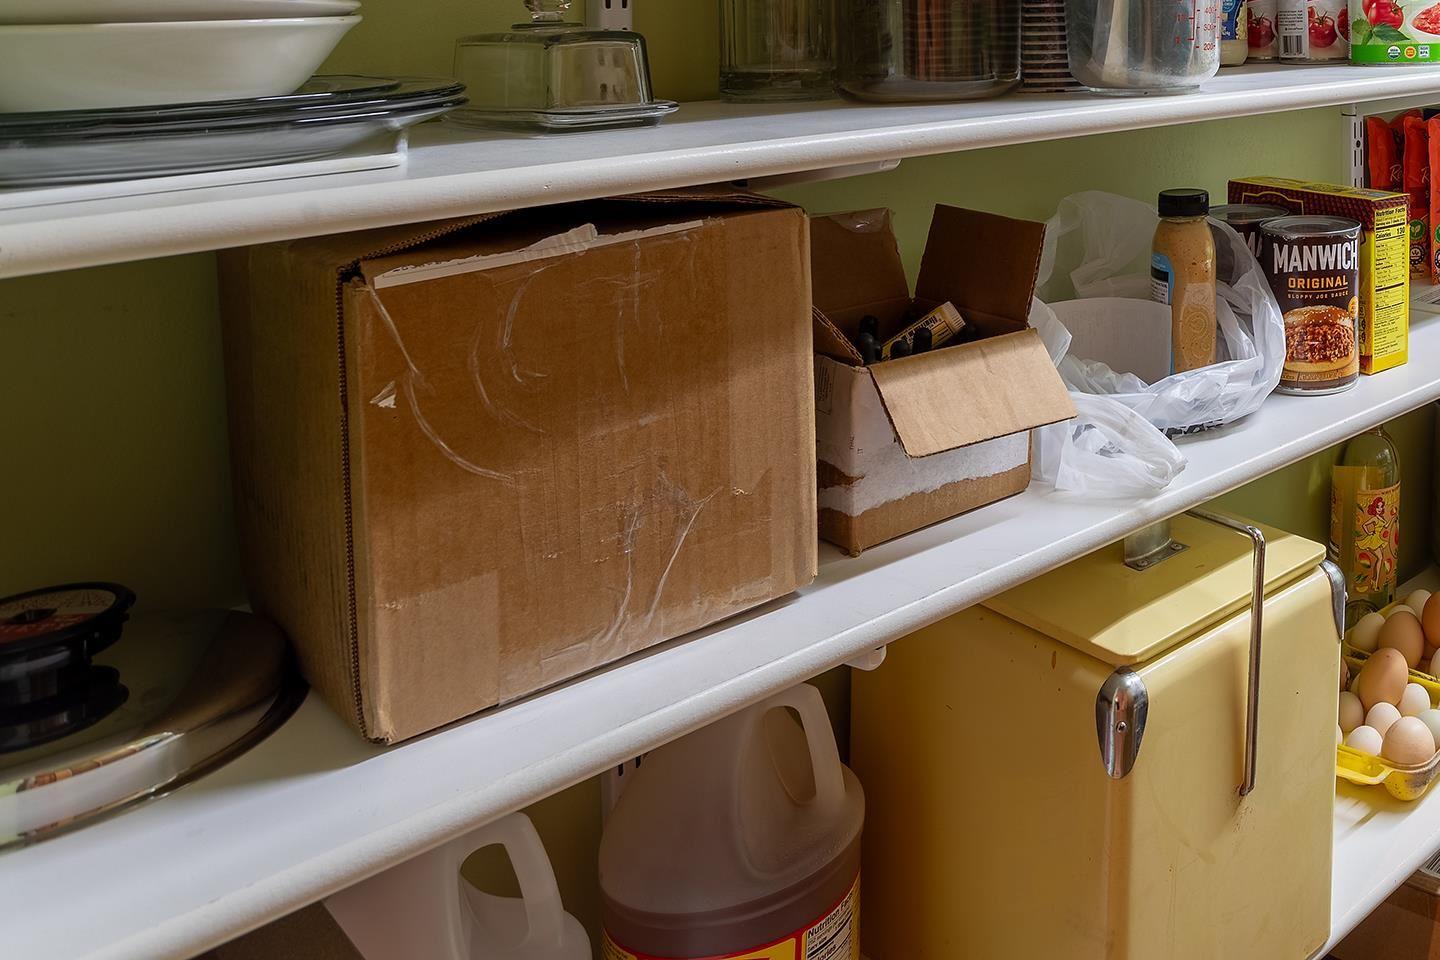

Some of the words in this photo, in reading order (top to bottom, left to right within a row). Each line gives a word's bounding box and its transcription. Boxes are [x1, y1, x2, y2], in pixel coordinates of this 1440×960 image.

[1375, 208, 1395, 217] Nutrition
[1395, 206, 1406, 214] Facts
[1375, 231, 1392, 239] Calories
[1273, 239, 1358, 275] MANWICH
[1288, 273, 1349, 289] ORIGINAL
[1287, 292, 1314, 300] SLOPPY
[1330, 290, 1349, 298] SAUCE
[807, 908, 840, 939] Nutrition
